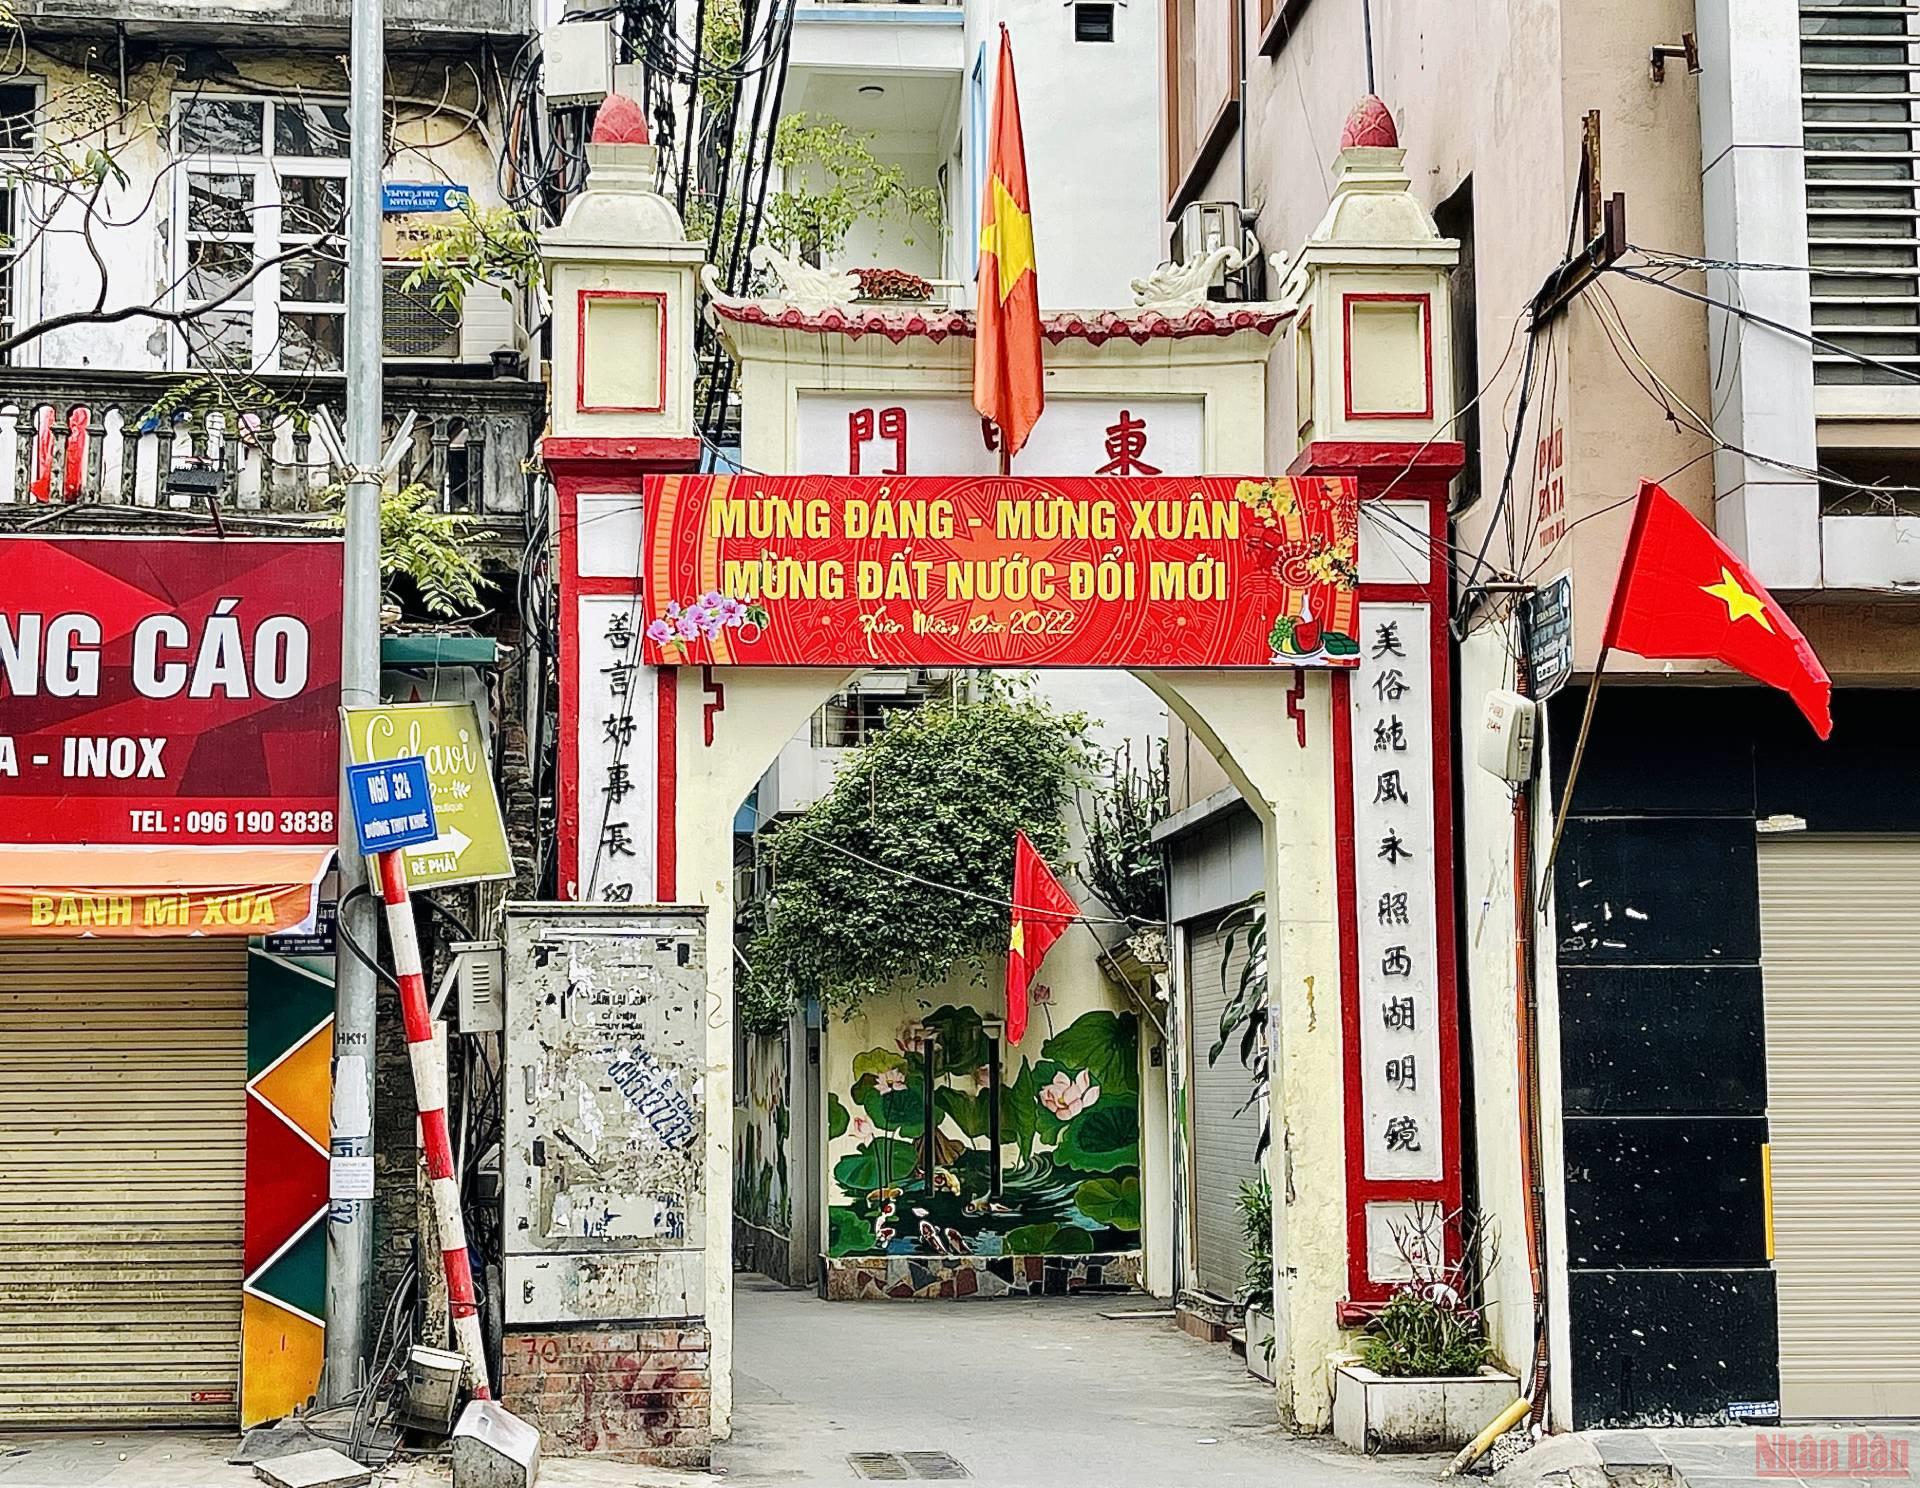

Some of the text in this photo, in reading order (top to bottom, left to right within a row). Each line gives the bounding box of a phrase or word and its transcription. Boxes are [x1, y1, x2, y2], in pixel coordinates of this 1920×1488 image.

[710, 491, 831, 539] MỪNG
[844, 486, 954, 539] ĐẢNG
[995, 491, 1116, 540] MỪNG
[1129, 492, 1240, 540] XUÂN
[724, 545, 1227, 600] MỪNG ĐẤT NƯỚC ĐỔI MỚI
[1009, 608, 1075, 634] 2022
[133, 597, 310, 700] CÁO
[63, 736, 167, 778] INOX
[392, 772, 412, 800] 324
[130, 810, 167, 833] TEL
[186, 810, 228, 833] 096
[234, 810, 274, 833] 190
[280, 810, 334, 833] 3838
[336, 1032, 367, 1045] HK11
[521, 1337, 560, 1364] 70
